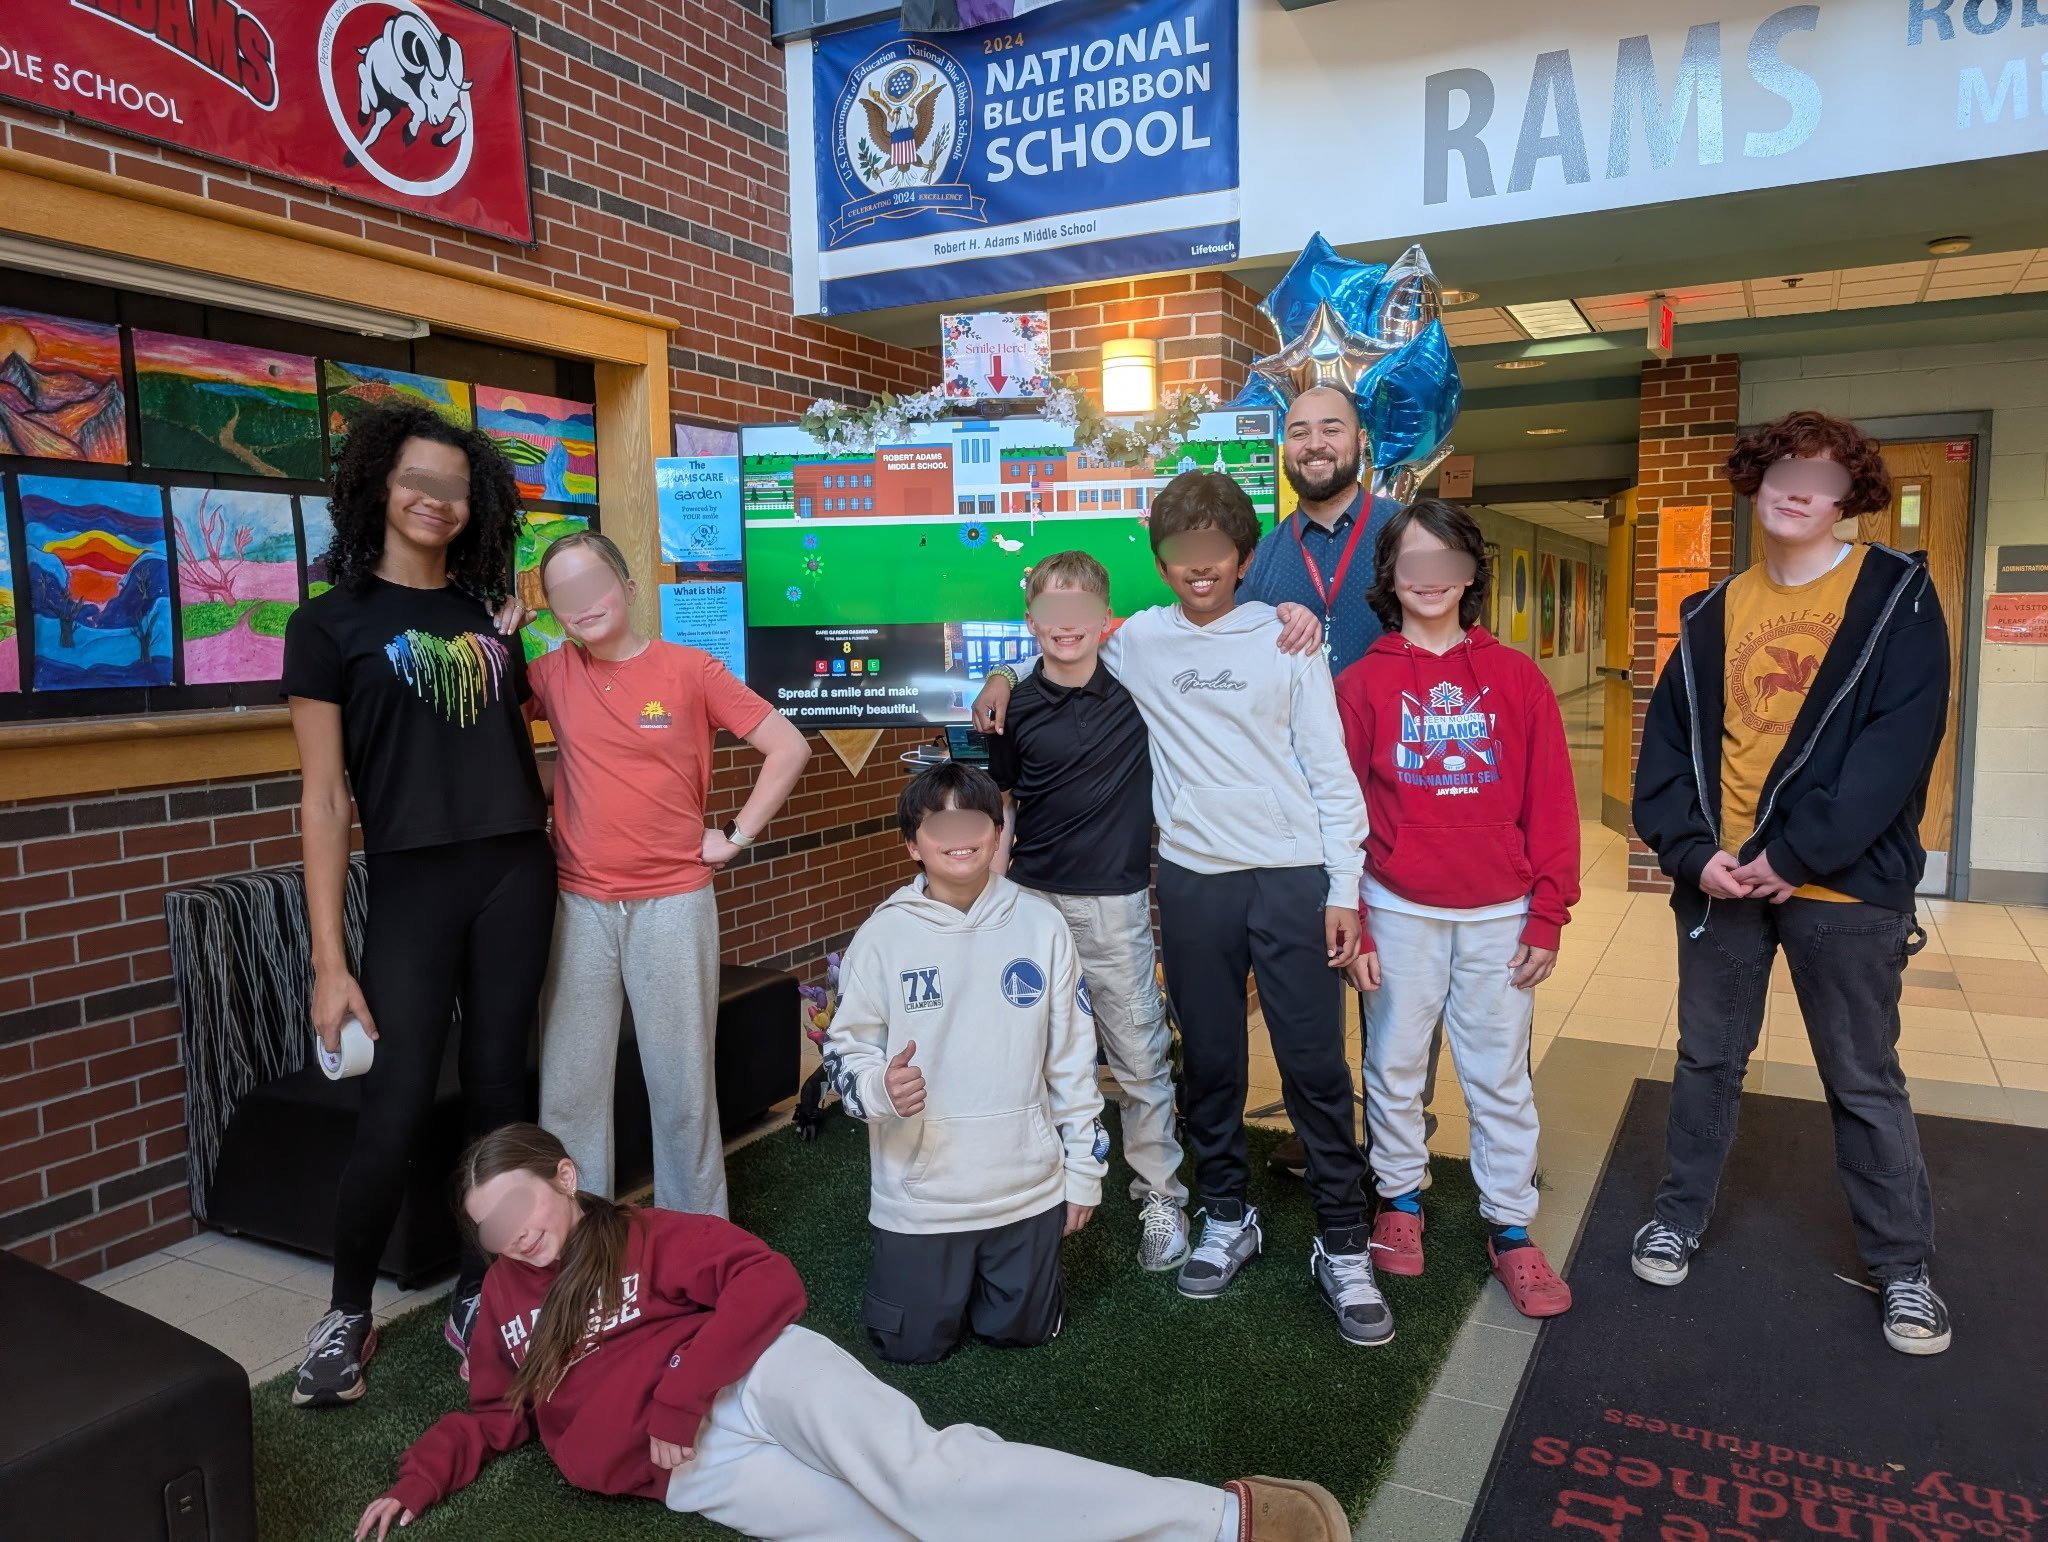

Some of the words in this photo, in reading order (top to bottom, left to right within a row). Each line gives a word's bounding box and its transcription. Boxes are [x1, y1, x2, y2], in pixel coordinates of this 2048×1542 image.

[320, 21, 335, 67] Personal
[983, 32, 1024, 55] 2024
[855, 50, 897, 82] Education
[907, 44, 945, 67] National
[985, 16, 1210, 96] NATIONAL
[944, 61, 960, 83] Blue
[53, 63, 184, 125] SCHOOL
[850, 76, 859, 93] of
[955, 81, 969, 117] Ribbon
[983, 88, 1066, 131] BLUE
[1074, 62, 1211, 114] RIBBON
[1423, 4, 1823, 206] RAMS
[837, 95, 853, 156] Department
[952, 119, 968, 161] Schools
[986, 105, 1211, 183] SCHOOL
[840, 156, 853, 181] U.S.
[848, 199, 892, 218] CELEBRATING
[893, 192, 916, 206] 2024
[918, 193, 963, 201] EXCELLENCE
[933, 240, 967, 256] Robert
[969, 238, 981, 251] H.
[984, 234, 1020, 249] Adams
[1023, 227, 1057, 244] Middle
[1060, 220, 1097, 237] School
[1191, 242, 1235, 256] Lifetouch
[965, 343, 995, 354] Smile
[998, 343, 1026, 354] Here!
[689, 461, 706, 470] The
[916, 453, 942, 461] ADAMS
[917, 462, 948, 470] SCHOOL
[674, 474, 698, 482] AMS
[699, 473, 724, 482] CARE
[674, 487, 722, 501] Garden
[709, 505, 717, 513] by
[673, 586, 697, 595] What
[698, 586, 706, 594] is
[707, 586, 726, 595] this?
[843, 642, 851, 653] 8
[778, 688, 819, 700] Spread
[830, 687, 862, 697] smile
[864, 687, 886, 697] and
[888, 686, 918, 696] make
[1172, 669, 1248, 694] Jordan
[801, 705, 863, 717] community
[866, 703, 919, 715] beautiful.
[1436, 788, 1451, 796] JAY
[1459, 786, 1479, 794] PEAK
[902, 969, 941, 1002] 7X
[906, 999, 942, 1011] CHAMPIONS
[1604, 1408, 1895, 1485] mindfulness
